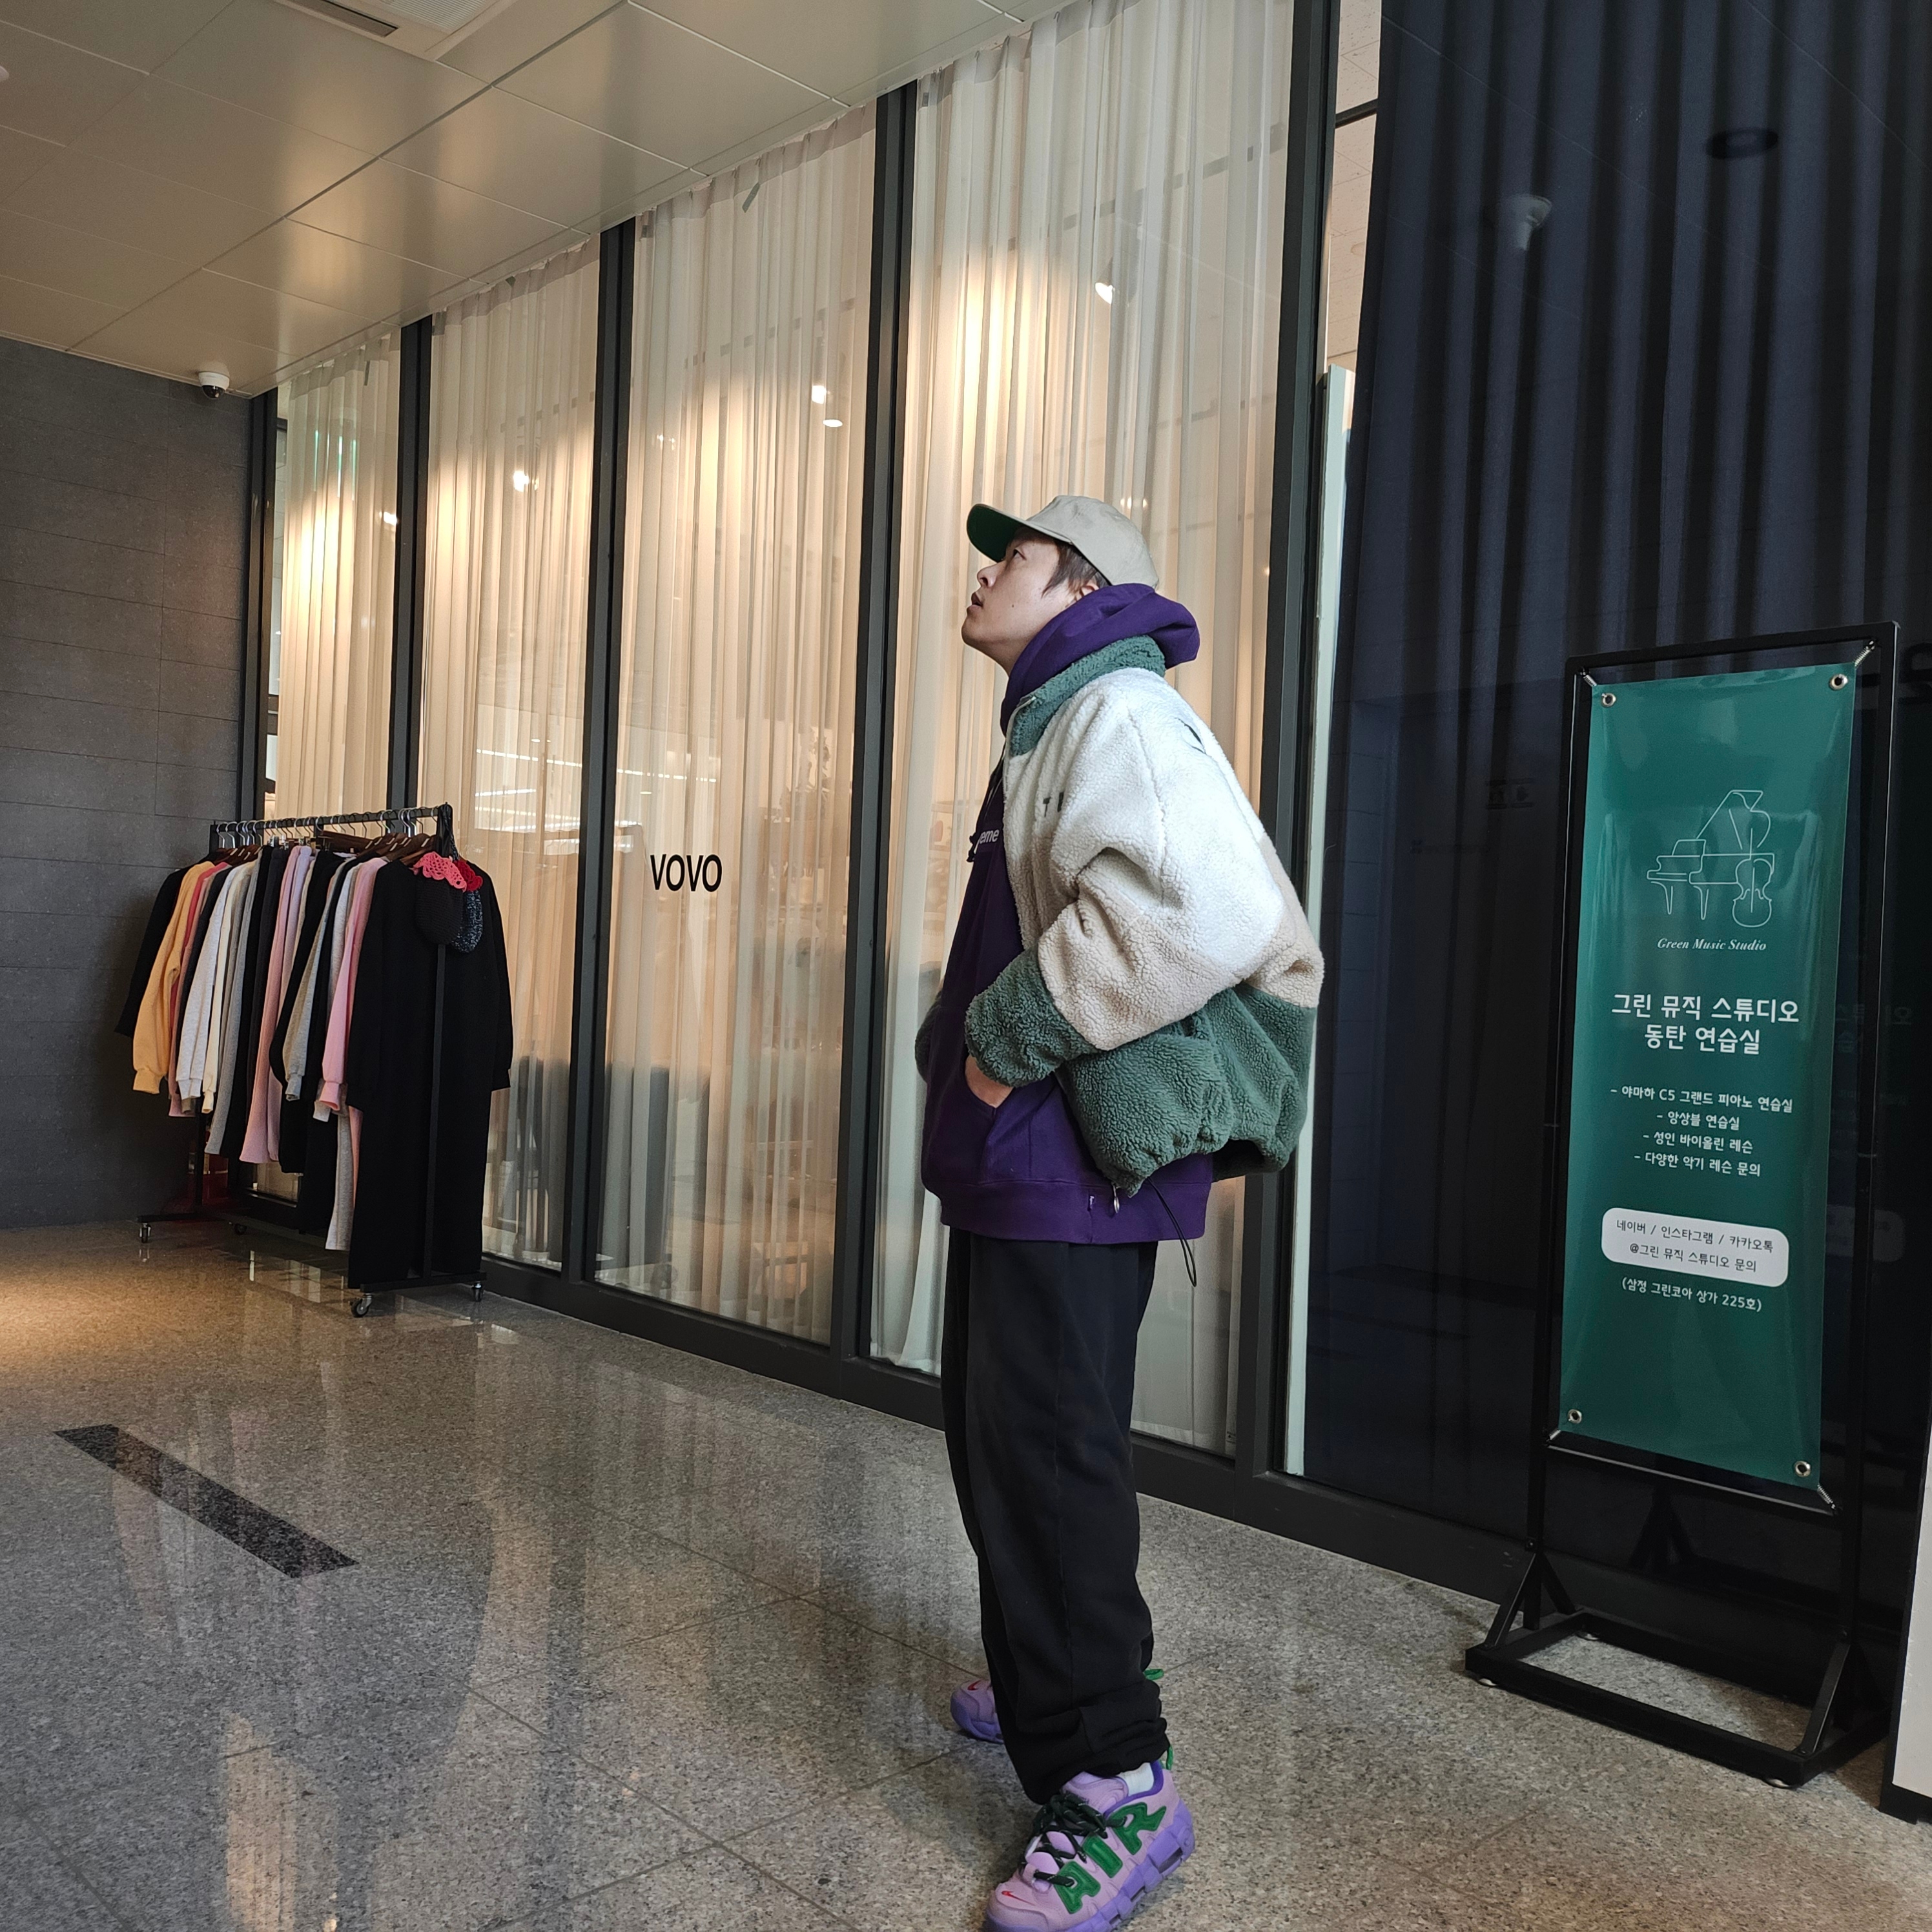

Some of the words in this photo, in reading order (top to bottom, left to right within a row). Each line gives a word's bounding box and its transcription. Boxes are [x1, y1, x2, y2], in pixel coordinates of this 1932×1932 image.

[650, 853, 723, 892] VOVO
[1657, 938, 1689, 949] Green
[1692, 938, 1726, 950] Music
[1727, 939, 1767, 951] Studio
[1611, 994, 1651, 1018] 그린
[1661, 996, 1701, 1021] 뮤직
[1711, 998, 1799, 1023] 스튜디오
[1644, 1024, 1687, 1050] 동탄
[1695, 1027, 1760, 1055] 연습실
[1621, 1085, 1656, 1100] 야마하
[1659, 1089, 1676, 1101] C5
[1679, 1091, 1714, 1105] 그랜드
[1718, 1093, 1752, 1108] 피아노
[1758, 1096, 1793, 1113] 연습실
[1667, 1111, 1701, 1127] 앙상블
[1705, 1115, 1740, 1131] 연습실
[1653, 1131, 1675, 1146] 성인
[1680, 1134, 1724, 1151] 바이올린
[1729, 1139, 1753, 1155] 레슨
[1645, 1152, 1679, 1168] 다양한
[1683, 1156, 1704, 1171] 악기
[1709, 1158, 1732, 1175] 레슨
[1737, 1162, 1760, 1177] 문의
[1616, 1220, 1646, 1235] 네이버
[1661, 1226, 1713, 1245] 인스타그램
[1729, 1236, 1773, 1253] 카카오톡
[1629, 1243, 1659, 1259] @그린
[1663, 1248, 1683, 1262] 뮤직
[1688, 1252, 1729, 1268] 스튜디오
[1734, 1259, 1756, 1273] 문의
[1622, 1277, 1647, 1293] (삼정
[1650, 1282, 1693, 1300] 그린코아
[1696, 1290, 1718, 1304] 상가
[1721, 1294, 1762, 1312] 225호)
[1053, 1802, 1166, 1915] AIR
